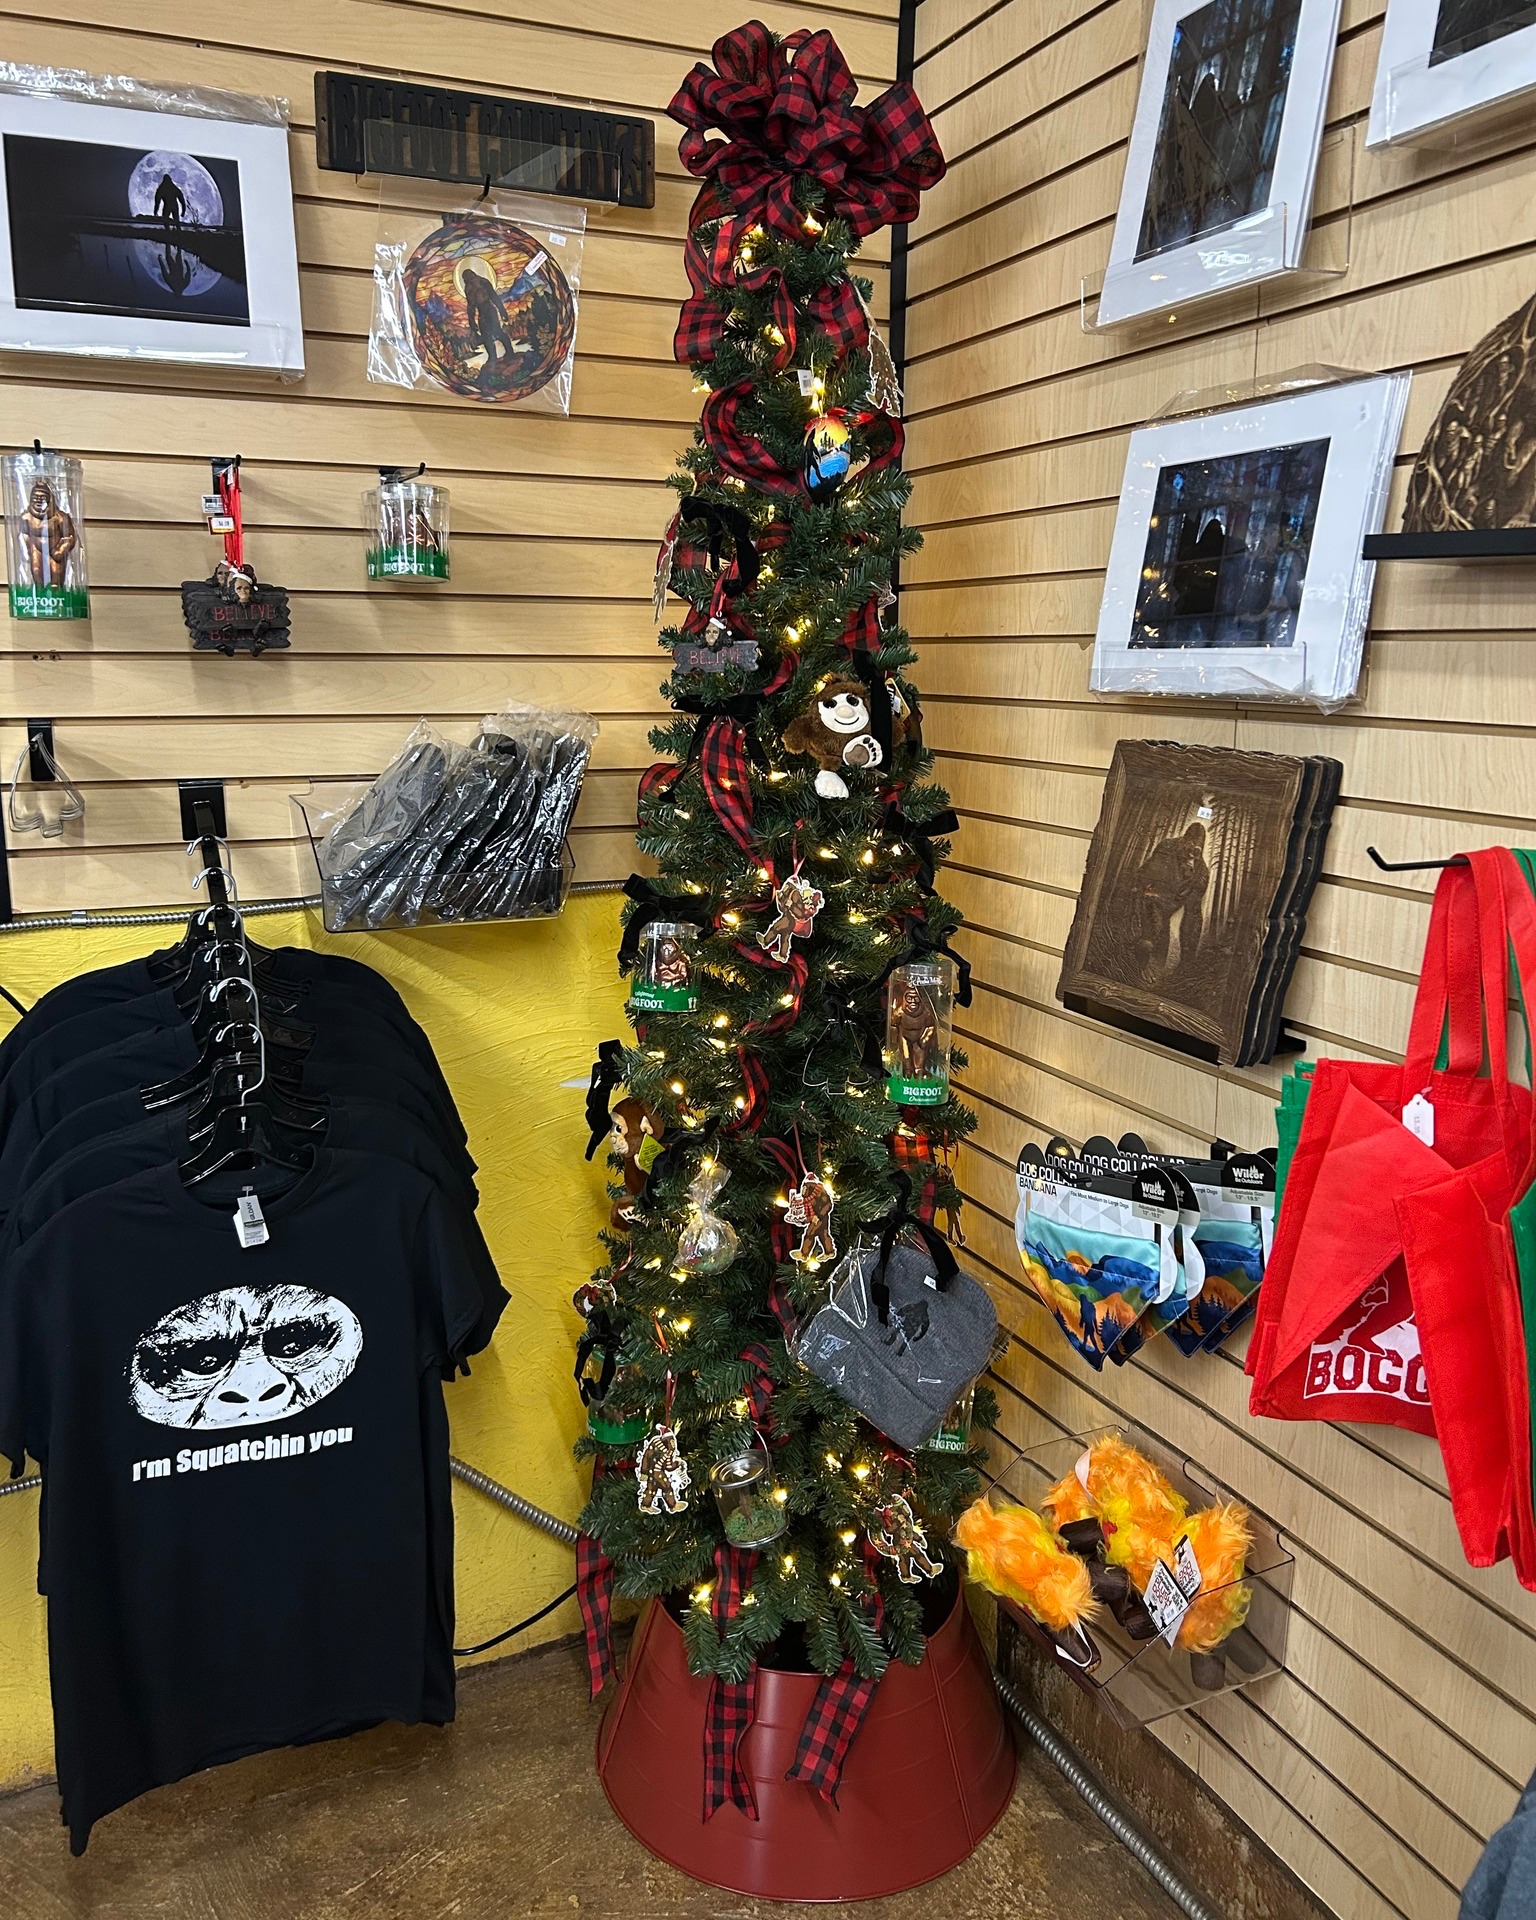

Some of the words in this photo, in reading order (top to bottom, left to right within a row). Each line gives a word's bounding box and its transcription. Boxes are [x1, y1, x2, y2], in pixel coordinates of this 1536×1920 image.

[329, 78, 472, 178] BIGFOOT
[477, 101, 619, 198] COUNTRY
[17, 596, 65, 607] BIGFOOT
[213, 604, 274, 621] BELIEVE
[689, 647, 743, 665] BELIEVE
[903, 1086, 943, 1096] BIGFOOT
[1020, 1161, 1038, 1177] DOG
[1232, 1165, 1265, 1180] Wilcor
[1141, 1181, 1166, 1196] Wilcor
[132, 1459, 171, 1482] I'm
[176, 1434, 305, 1473] Squatchin
[309, 1427, 353, 1453] you
